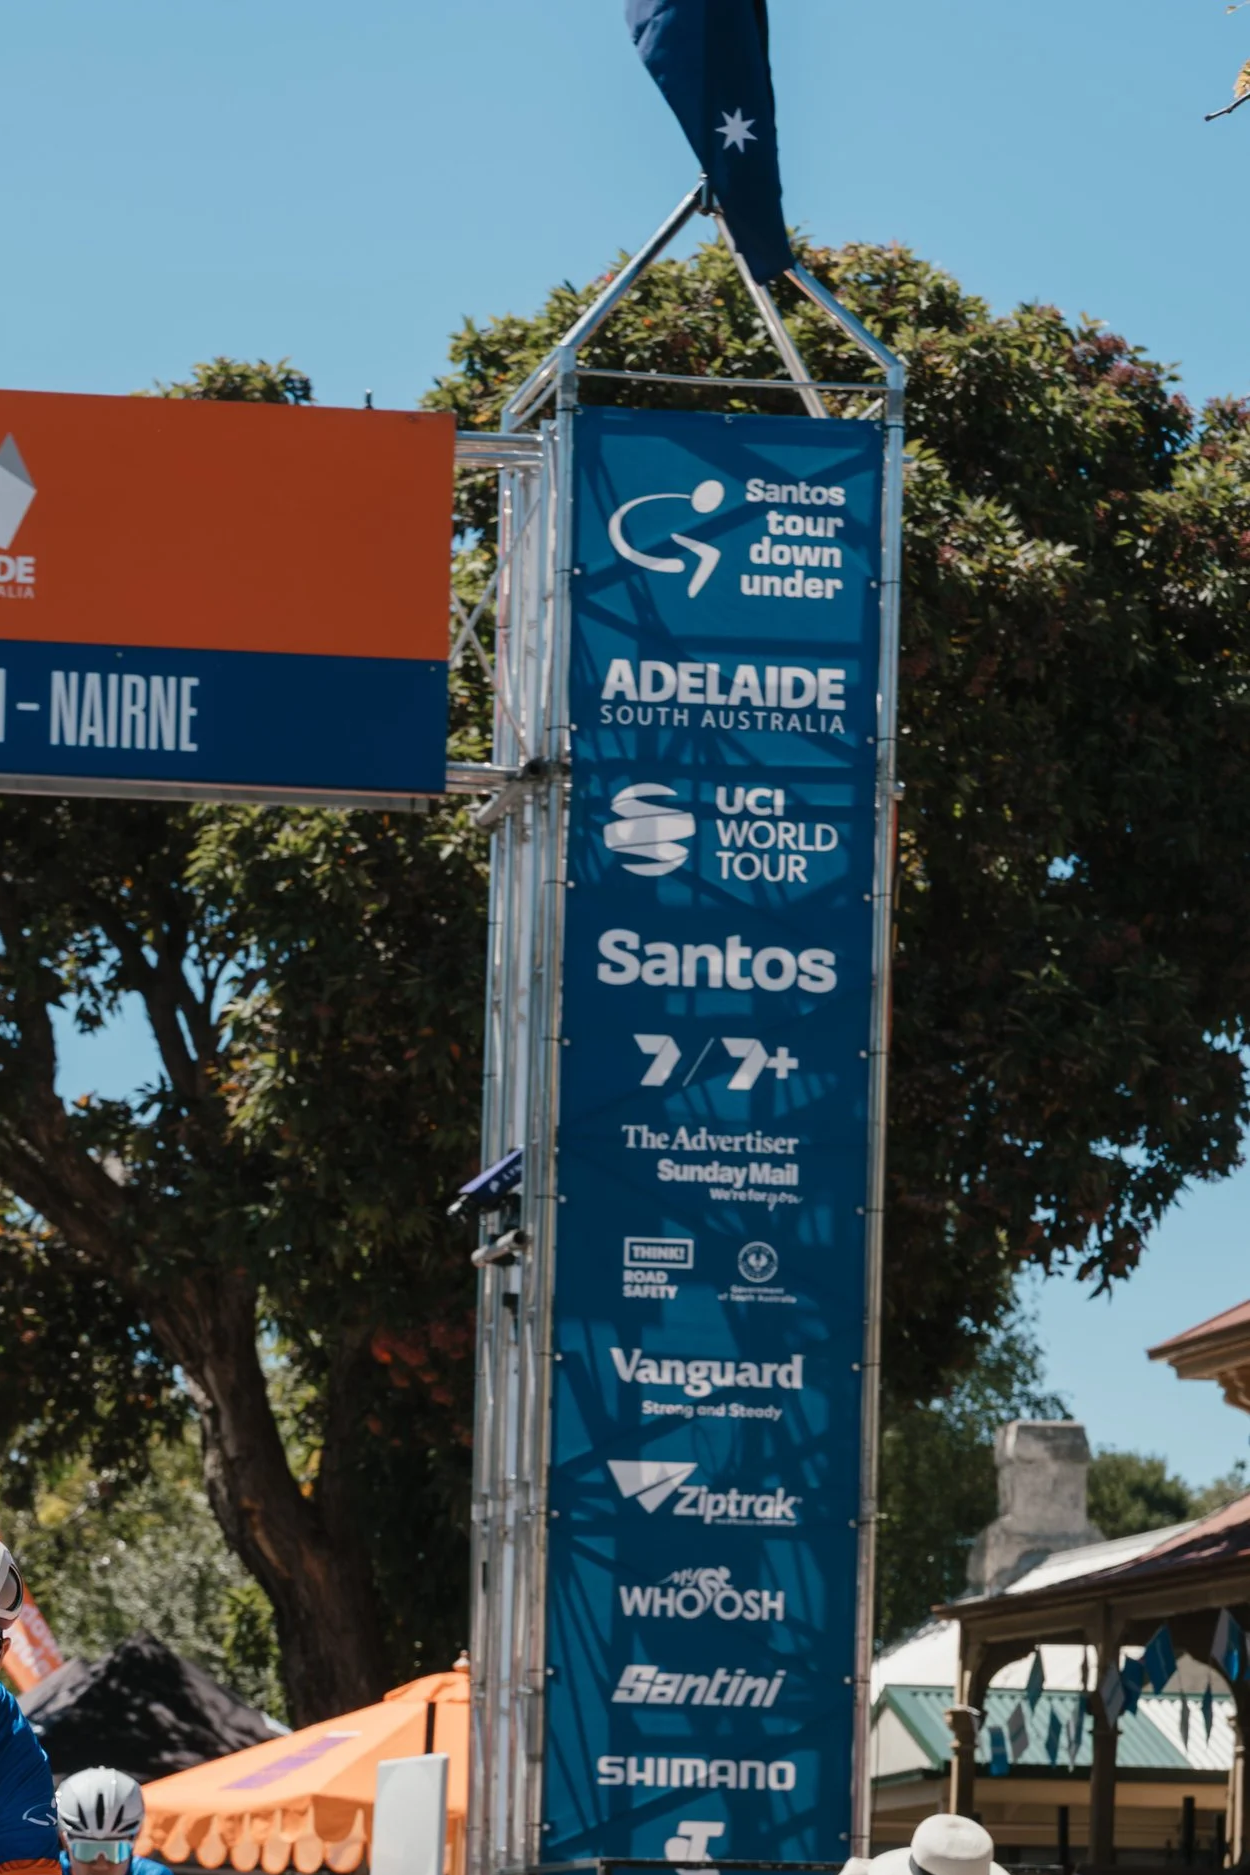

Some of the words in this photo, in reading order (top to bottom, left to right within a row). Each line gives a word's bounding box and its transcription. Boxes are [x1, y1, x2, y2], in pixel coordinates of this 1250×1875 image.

[745, 477, 847, 507] Santos
[767, 510, 844, 538] tour
[749, 537, 843, 569] down
[739, 569, 844, 600] under
[601, 658, 847, 711] ADELAIDE
[50, 671, 200, 753] NAIRNE
[600, 704, 691, 728] SOUTH
[700, 710, 846, 735] AUSTRALIA
[715, 786, 785, 817] UCI
[716, 820, 839, 853] WORLD
[716, 851, 809, 884] TOUR
[597, 928, 838, 994] Santos
[621, 1124, 669, 1151] The
[671, 1125, 800, 1156] Advertiser
[656, 1158, 748, 1189] Sunday
[748, 1162, 799, 1186] Mail
[631, 1244, 686, 1261] THINK!
[623, 1270, 668, 1284] ROAD
[623, 1284, 679, 1300] SAFETY
[610, 1348, 805, 1398] Vanguard
[642, 1400, 694, 1419] Strong
[696, 1402, 726, 1417] and
[728, 1402, 783, 1421] Steady
[672, 1484, 797, 1525] Ziptrak
[619, 1584, 786, 1622] WHOOSH
[611, 1664, 787, 1708] Santini
[596, 1756, 797, 1792] SHIMANO
